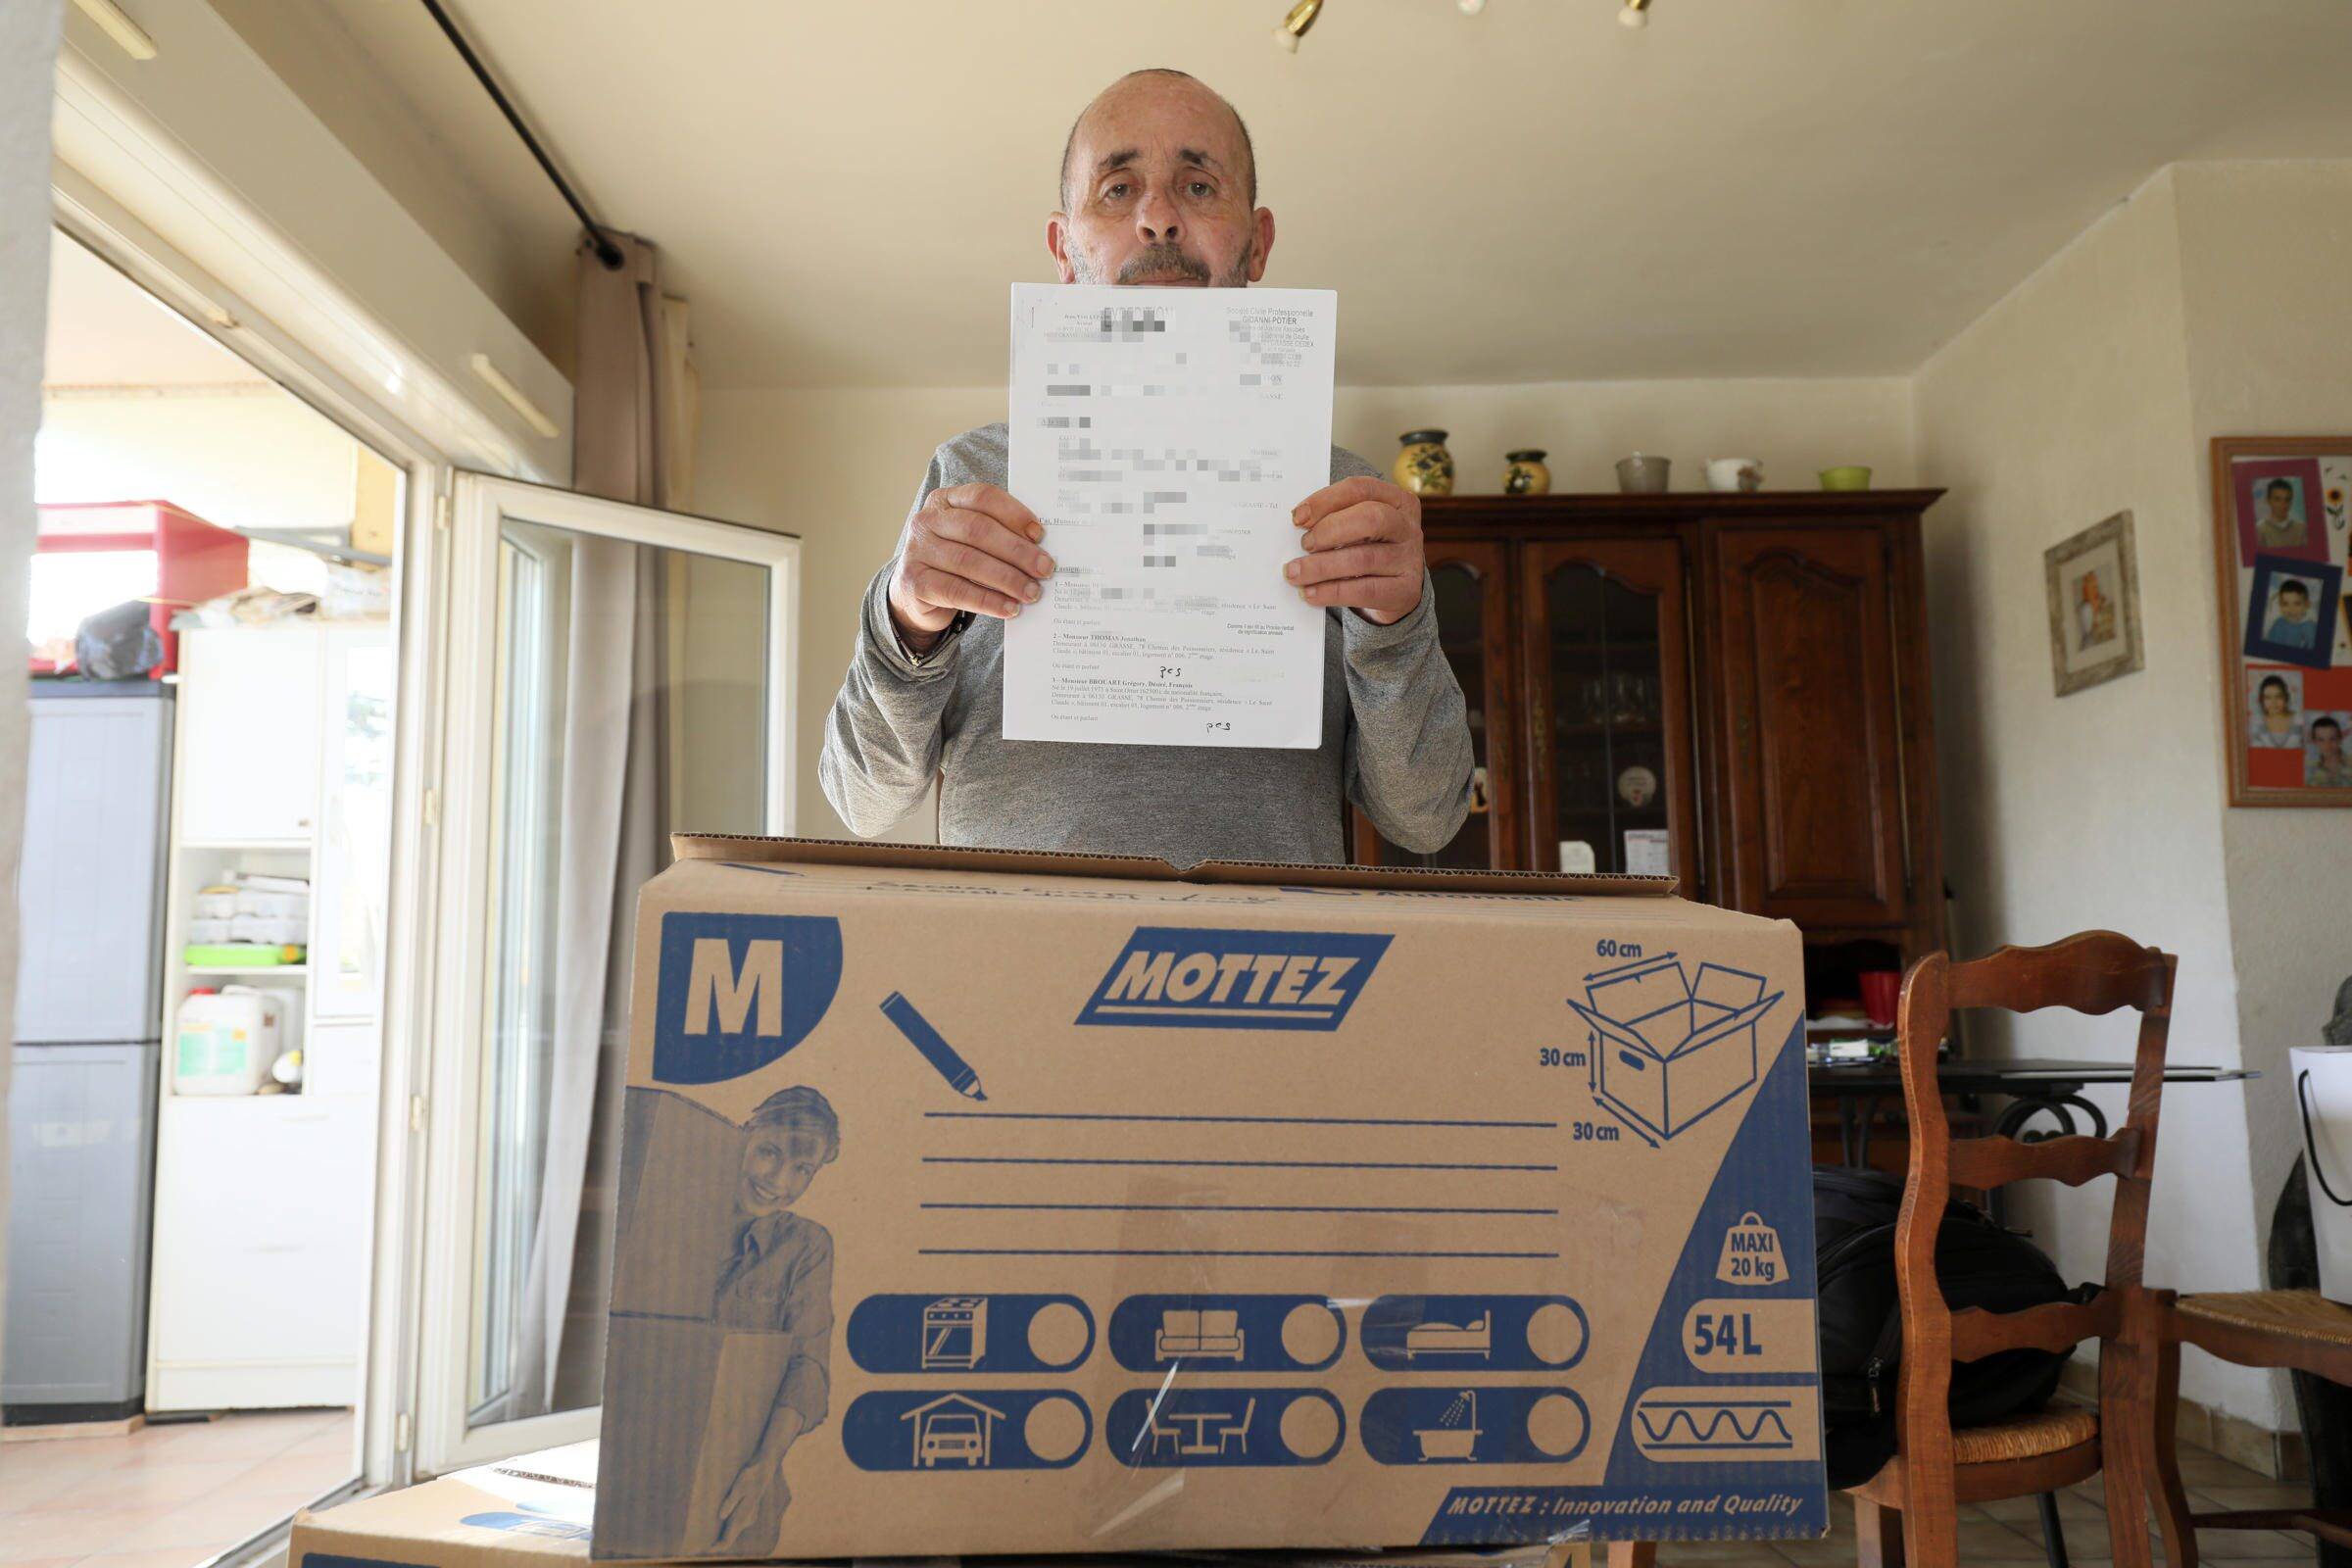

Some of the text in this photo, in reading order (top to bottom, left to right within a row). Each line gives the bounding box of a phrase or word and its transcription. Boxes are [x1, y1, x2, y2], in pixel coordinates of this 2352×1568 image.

[1596, 939, 1642, 957] 60 cm
[683, 938, 783, 1038] M
[1104, 951, 1362, 1007] MOTTEZ
[1540, 1049, 1587, 1067] 30 cm
[1573, 1123, 1619, 1142] 30 cm
[1731, 1233, 1774, 1253] MAXI
[1731, 1255, 1776, 1282] 20 kg
[1447, 1494, 1537, 1517] MOTTEZ
[1554, 1496, 1671, 1517] Innovation
[1678, 1495, 1718, 1515] and
[1723, 1494, 1804, 1518] Quality
